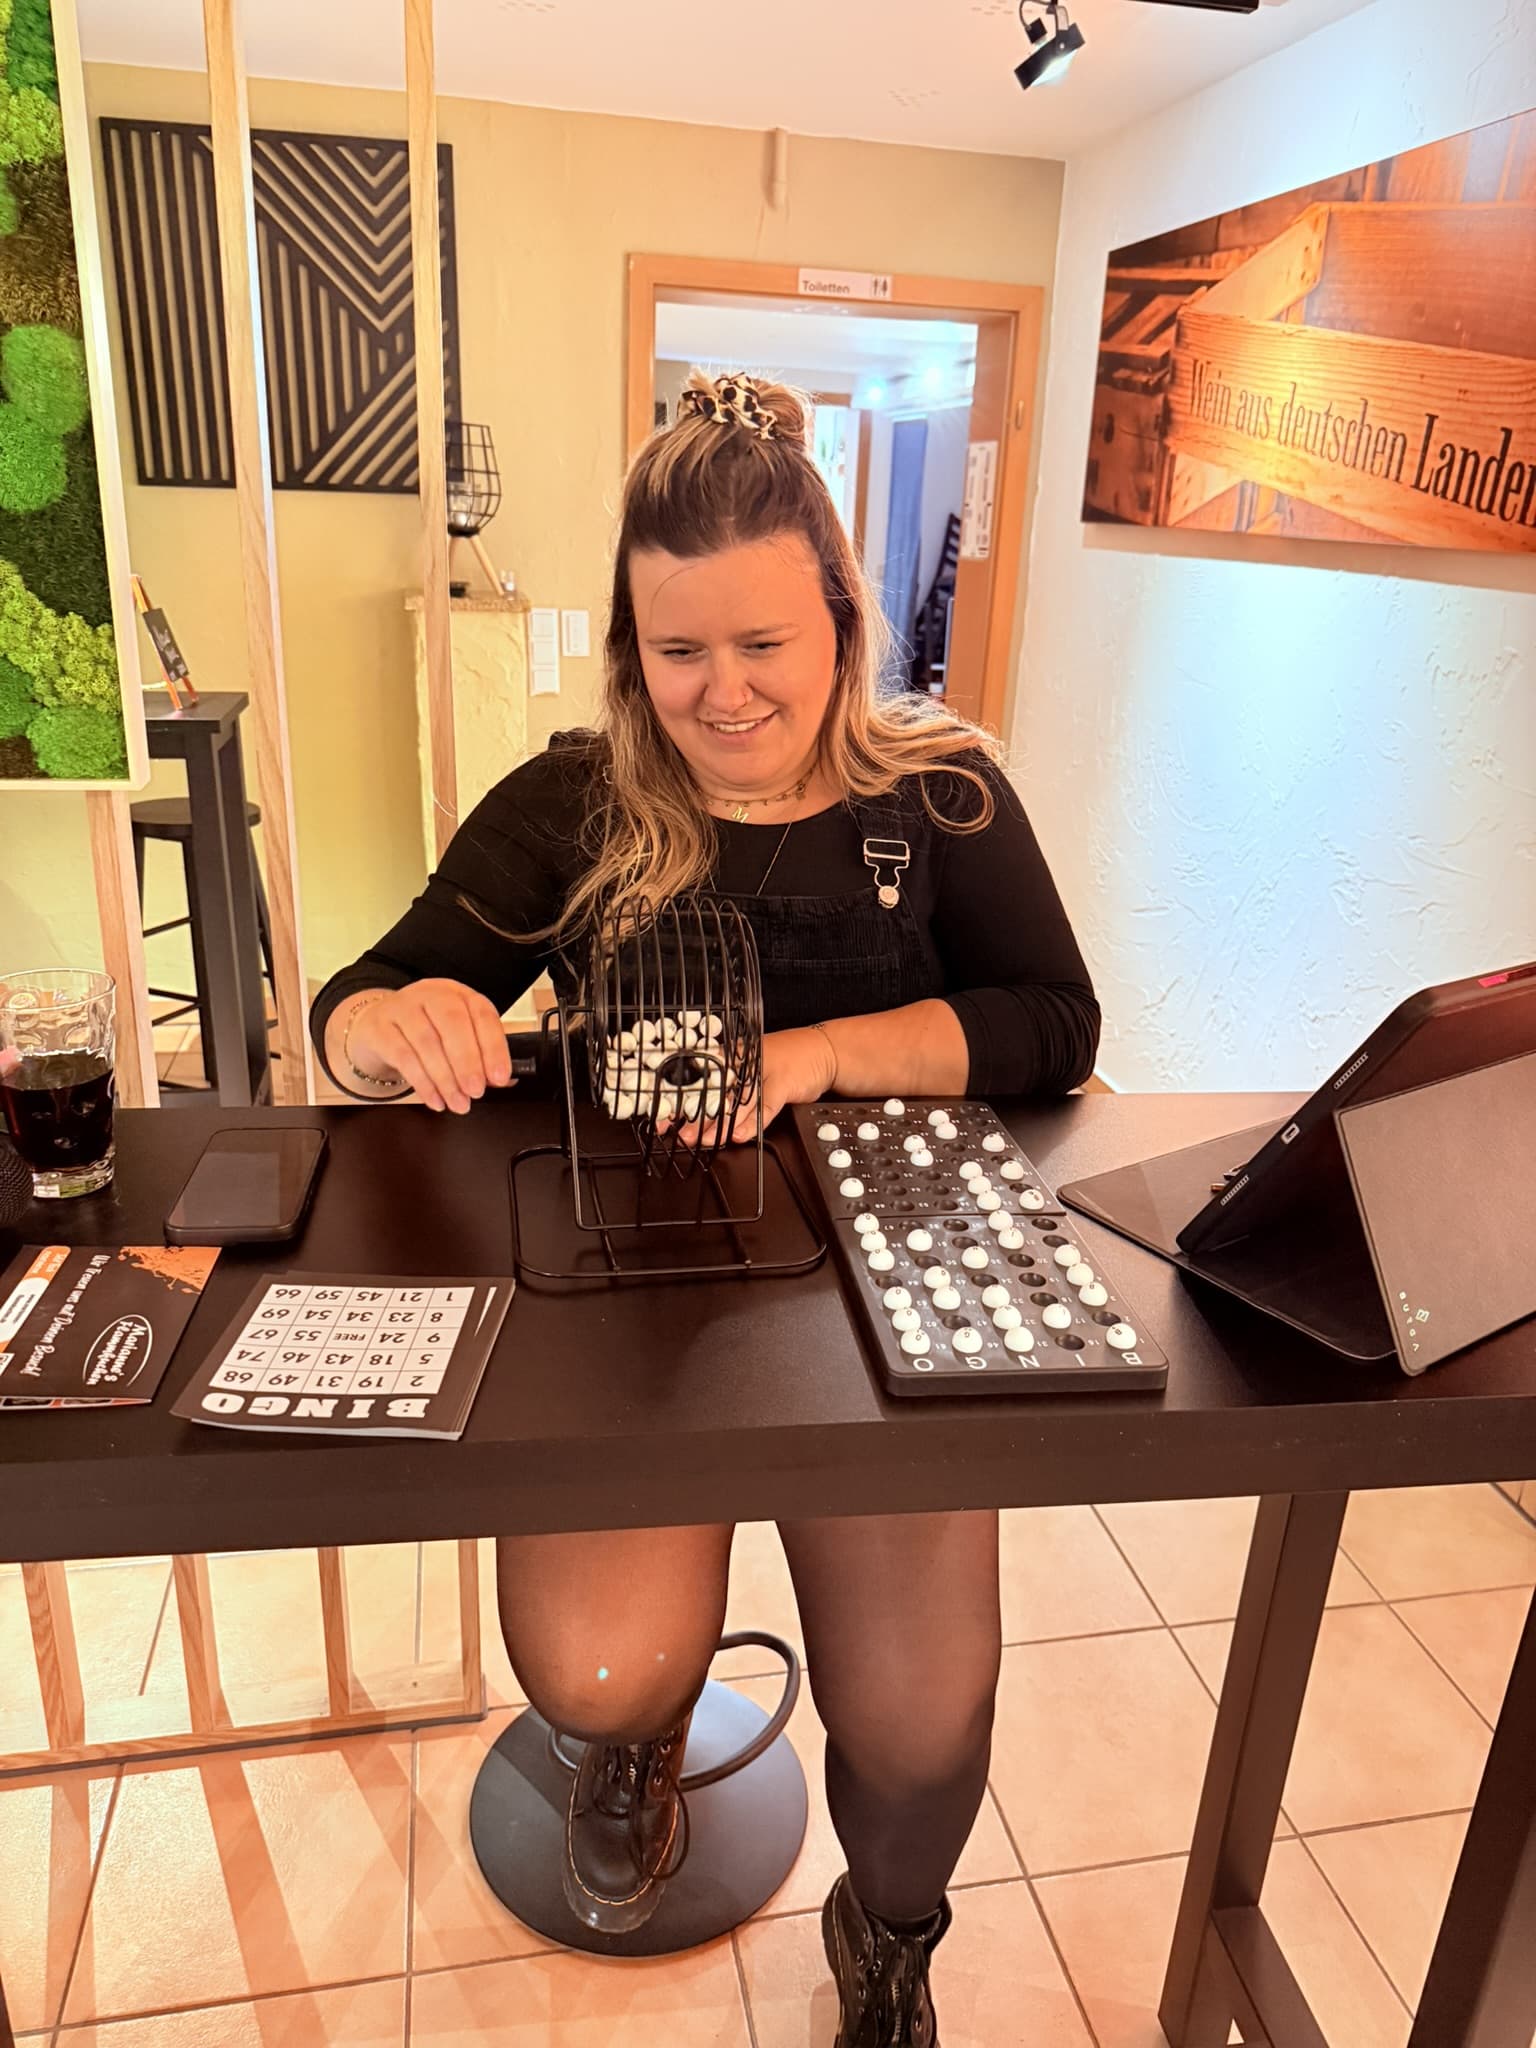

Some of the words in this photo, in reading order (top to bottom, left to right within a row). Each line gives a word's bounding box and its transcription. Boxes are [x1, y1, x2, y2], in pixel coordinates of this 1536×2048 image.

[802, 280, 850, 294] Toiletten
[1188, 358, 1232, 428] Wein
[1235, 389, 1273, 441] aus
[1277, 381, 1408, 484] deutschen
[90, 1254, 111, 1267] Wir
[275, 1288, 302, 1299] 66
[315, 1290, 343, 1300] 59
[356, 1291, 383, 1301] 45
[400, 1292, 424, 1301] 21
[446, 1292, 453, 1301] 1
[262, 1308, 290, 1319] 69
[305, 1310, 332, 1320] 54
[347, 1312, 374, 1322] 34
[389, 1312, 415, 1322] 23
[430, 1312, 443, 1322] 8
[40, 1316, 73, 1344] Deinen
[248, 1329, 278, 1339] 67
[293, 1330, 322, 1341] 55
[334, 1333, 366, 1341] FREE
[380, 1333, 406, 1343] 24
[427, 1333, 440, 1343] 9
[85, 1320, 134, 1385] Flammkuchen
[103, 1323, 147, 1382] Marianne's
[237, 1350, 266, 1361] 74
[283, 1352, 311, 1363] 46
[19, 1344, 55, 1377] Besuch!
[325, 1353, 354, 1365] 43
[369, 1354, 393, 1365] 18
[419, 1354, 434, 1365] 5
[224, 1371, 253, 1383] 68
[269, 1374, 299, 1386] 49
[316, 1376, 343, 1387] 31
[358, 1376, 384, 1388] 19
[410, 1376, 425, 1387] 2
[201, 1392, 431, 1418] BINGO
